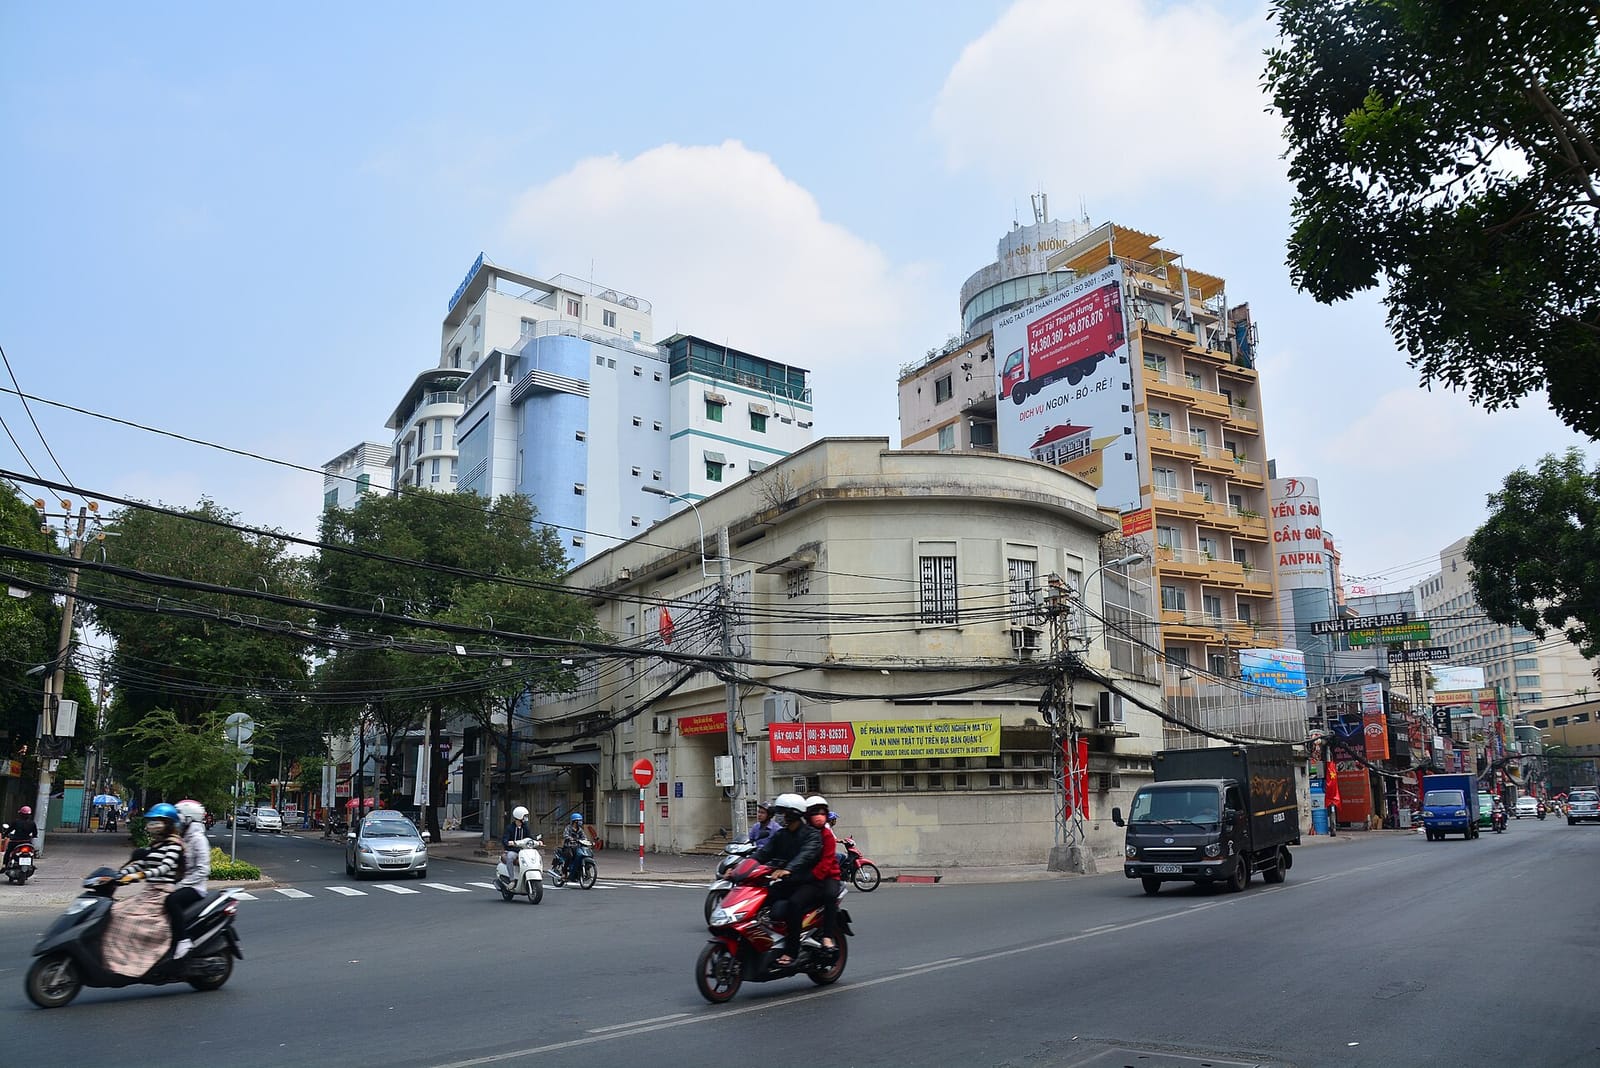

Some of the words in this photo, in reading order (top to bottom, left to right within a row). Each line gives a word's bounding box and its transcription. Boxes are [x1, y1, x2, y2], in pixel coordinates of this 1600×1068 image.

[1014, 310, 1026, 323] TAXI
[1068, 309, 1104, 338] 39.876.876
[1032, 325, 1044, 338] Taxi
[1045, 393, 1070, 411] NGON
[1272, 501, 1295, 518] YẾN
[1300, 501, 1320, 516] SÀO
[1274, 525, 1301, 542] CẦN
[1305, 525, 1321, 540] GIỜ
[1280, 554, 1322, 566] ANPHA
[1314, 620, 1344, 633] LINH
[1347, 613, 1403, 630] PERFUME
[1366, 633, 1413, 644] Restaurant
[1431, 649, 1448, 659] HOA
[916, 725, 925, 733] TIN
[879, 738, 887, 746] AN
[776, 745, 791, 754] Please
[792, 745, 800, 754] call
[861, 749, 883, 757] REPORTING
[925, 748, 934, 756] AND
[950, 747, 965, 755] SAFETY
[971, 746, 989, 754] DISTRICT
